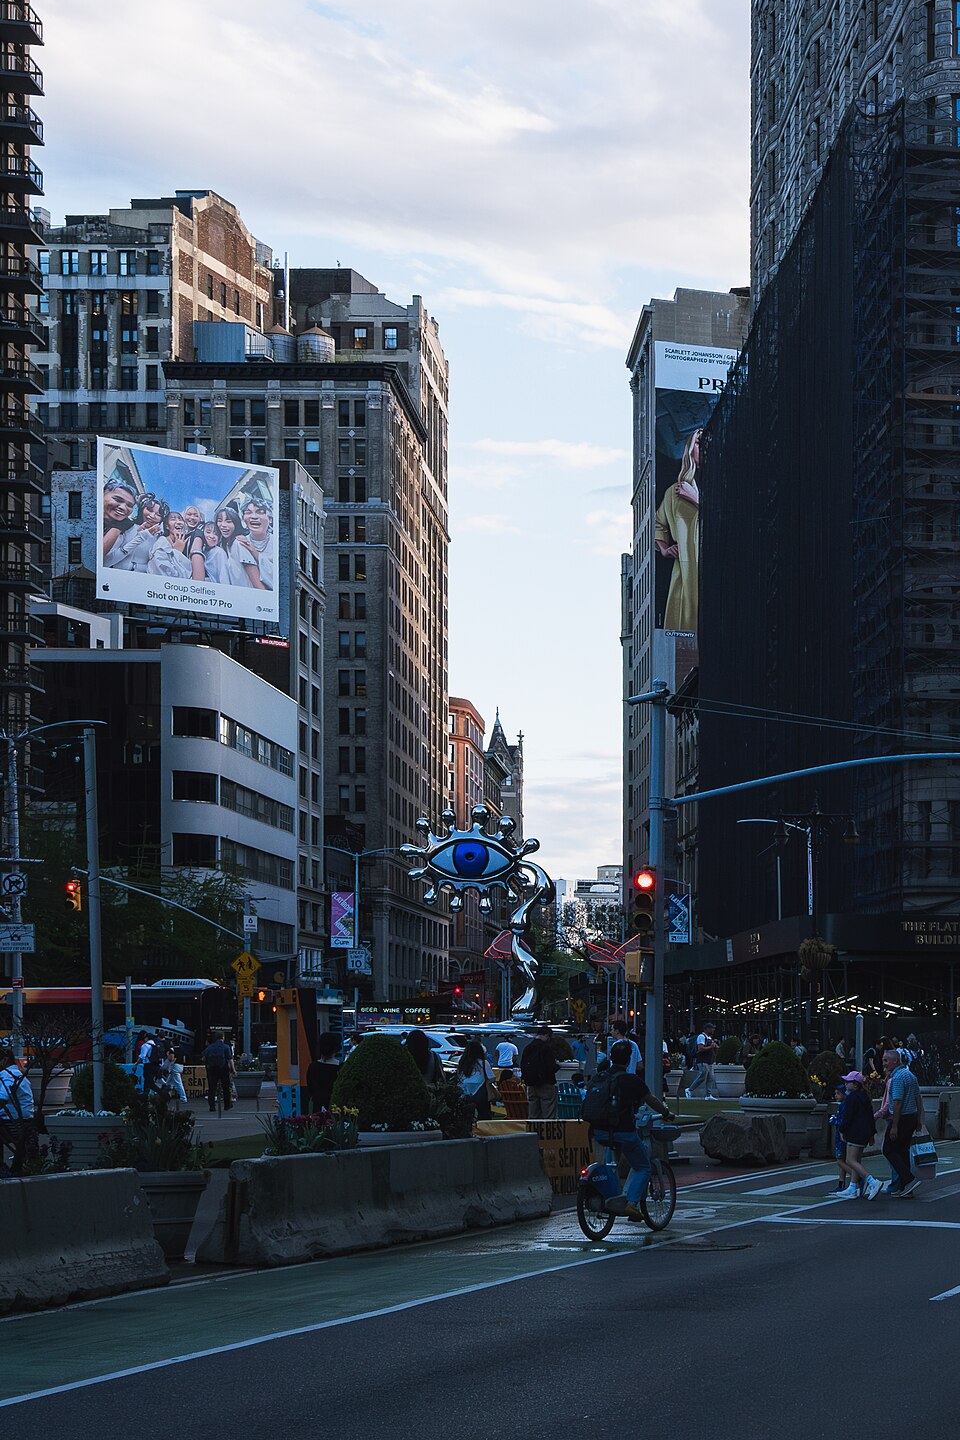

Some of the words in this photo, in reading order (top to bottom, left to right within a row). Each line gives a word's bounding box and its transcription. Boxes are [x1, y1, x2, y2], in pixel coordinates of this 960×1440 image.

[664, 348, 690, 356] SCARLETT
[691, 351, 723, 359] JOHANSSON
[664, 354, 707, 363] PHOTOGRAPHED
[164, 582, 188, 593] Group
[190, 586, 216, 596] Selfies
[147, 590, 166, 600] Shot
[180, 595, 208, 606] iPhone
[219, 600, 232, 609] Pro
[900, 921, 926, 931] THE
[351, 960, 362, 968] 10
[188, 1078, 207, 1090] SEAT
[545, 1121, 566, 1147] BEST
[559, 1147, 578, 1171] SEAT
